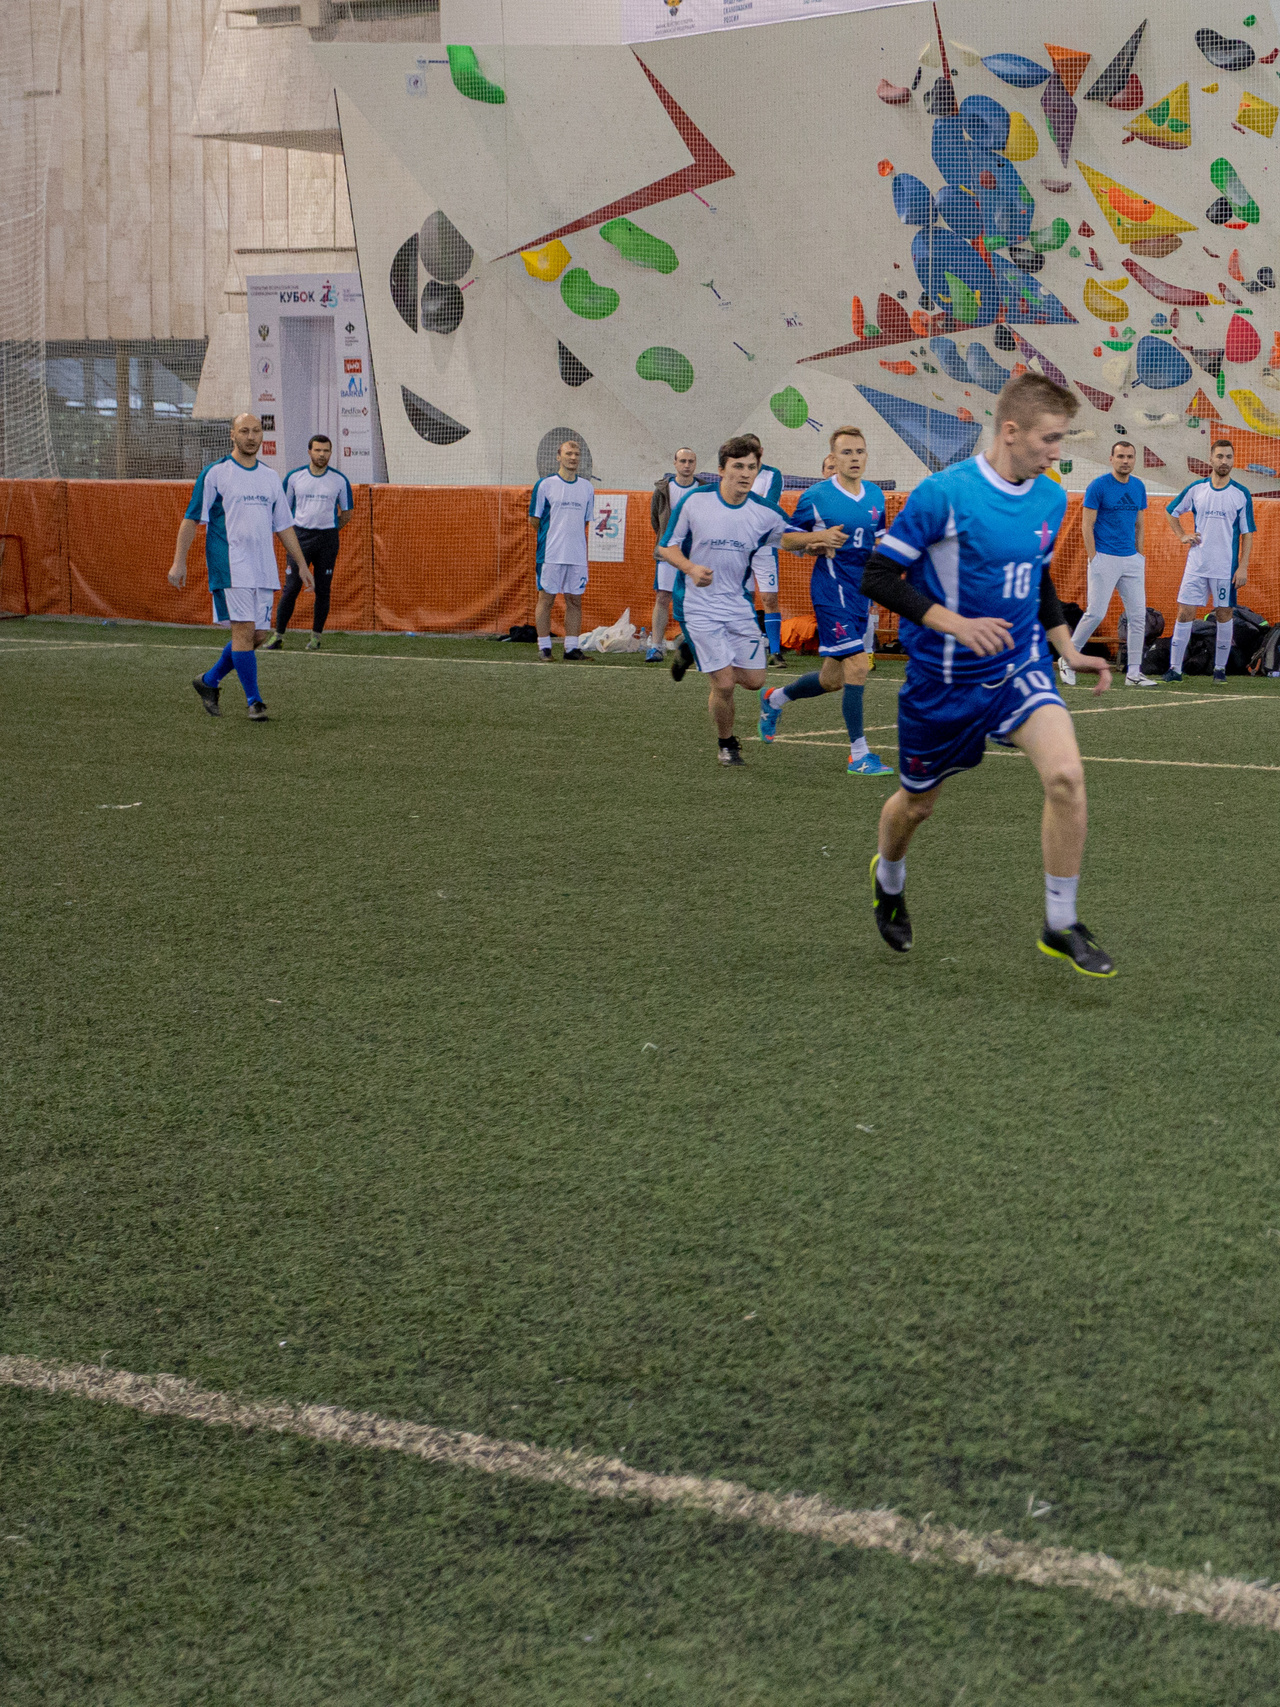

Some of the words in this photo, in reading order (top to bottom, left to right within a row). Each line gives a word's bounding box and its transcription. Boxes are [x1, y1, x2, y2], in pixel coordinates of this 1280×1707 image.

[280, 291, 316, 303] КУБОК
[852, 527, 864, 548] 9
[768, 573, 776, 586] 3
[1002, 561, 1034, 599] 10
[1218, 587, 1227, 600] 8
[750, 640, 759, 660] 7
[1012, 670, 1052, 697] 10
